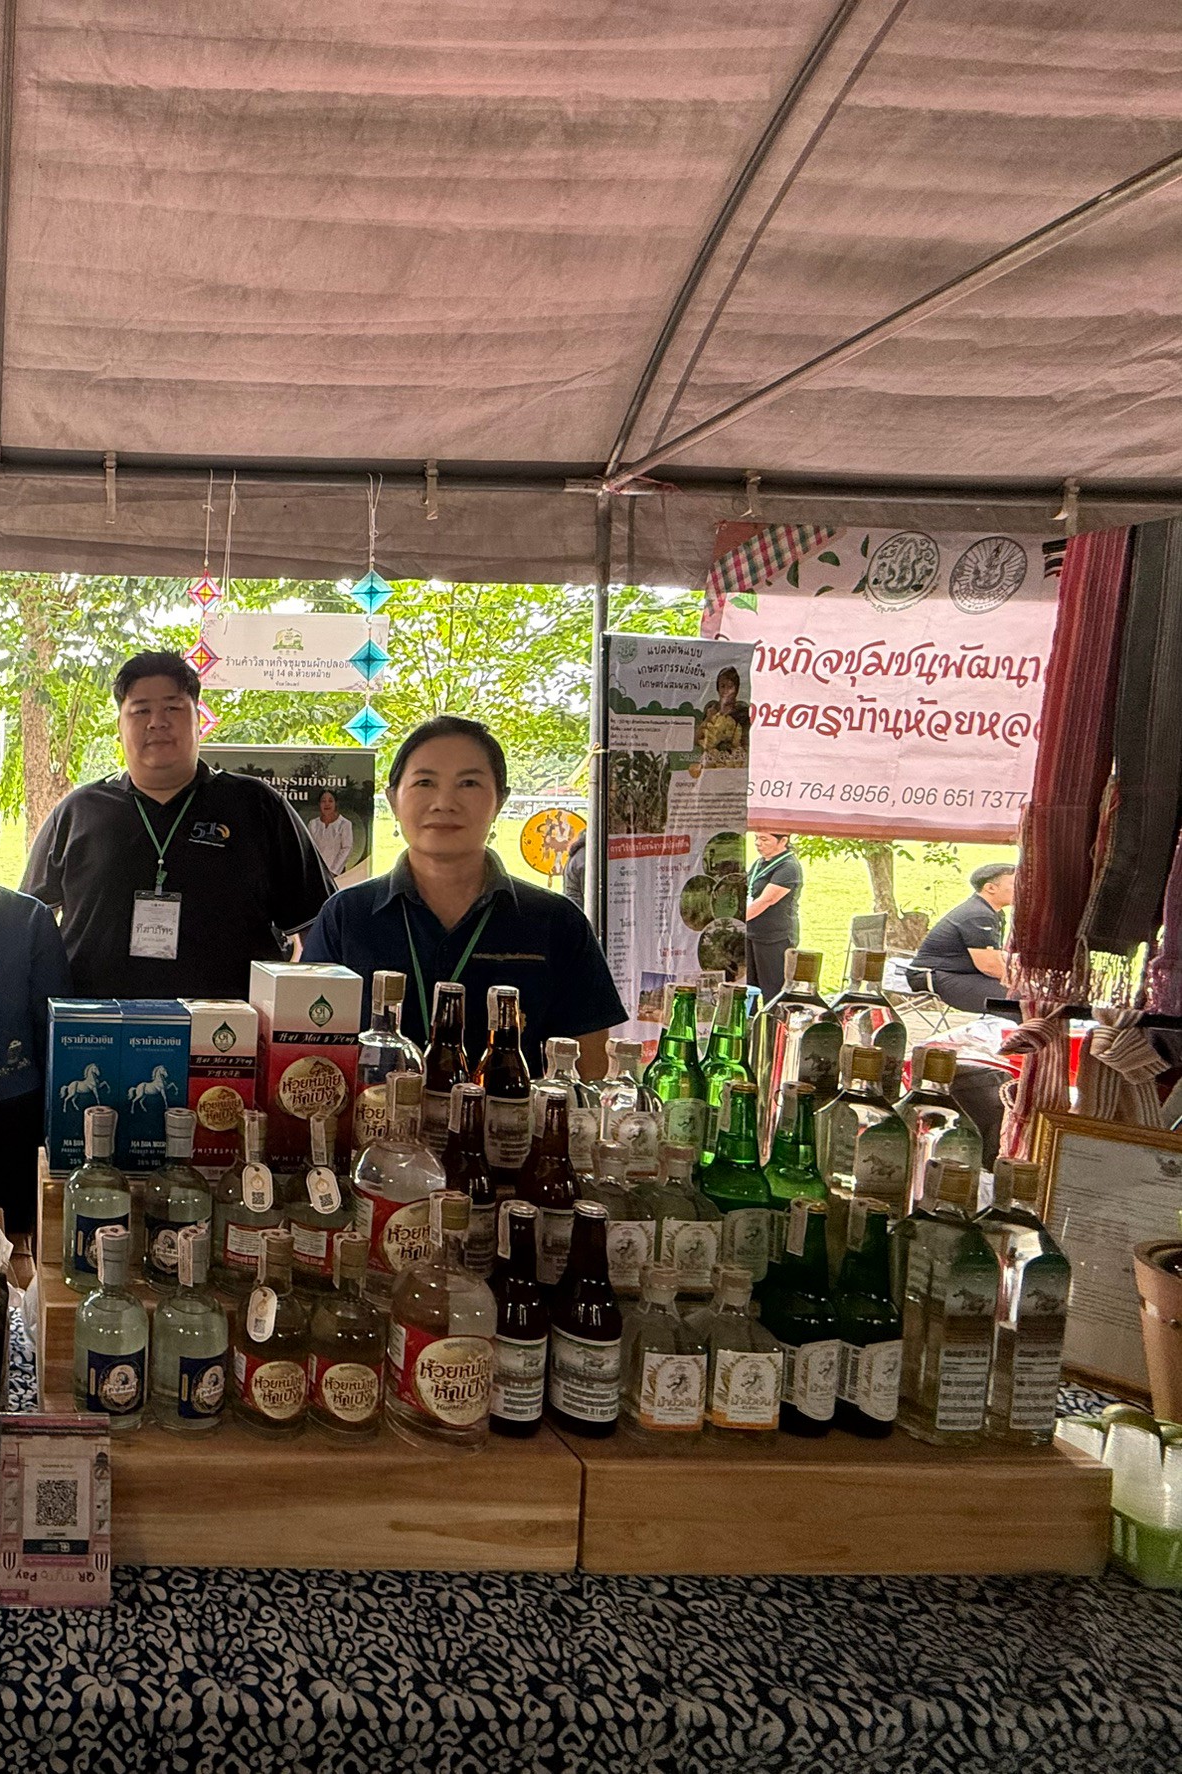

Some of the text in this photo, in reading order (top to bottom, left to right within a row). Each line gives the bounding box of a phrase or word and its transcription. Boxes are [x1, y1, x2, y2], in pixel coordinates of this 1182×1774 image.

[647, 642, 703, 659] แปลงต้นแบบ
[226, 656, 354, 670] ร้านค้าวิสาหกิจชุมชนผักปลอด
[637, 660, 706, 678] เกษตรกรรมยั่งยืน
[277, 669, 285, 677] 14
[749, 694, 1042, 748] ษตรบ้านห้วยหล
[759, 779, 793, 798] 081
[799, 781, 836, 801] 764
[901, 786, 938, 806] 096
[945, 788, 975, 807] 651
[981, 790, 1028, 809] 7377
[356, 1103, 386, 1120] ห้วย
[15, 1569, 38, 1583] Pay
[78, 1572, 95, 1583] QR
